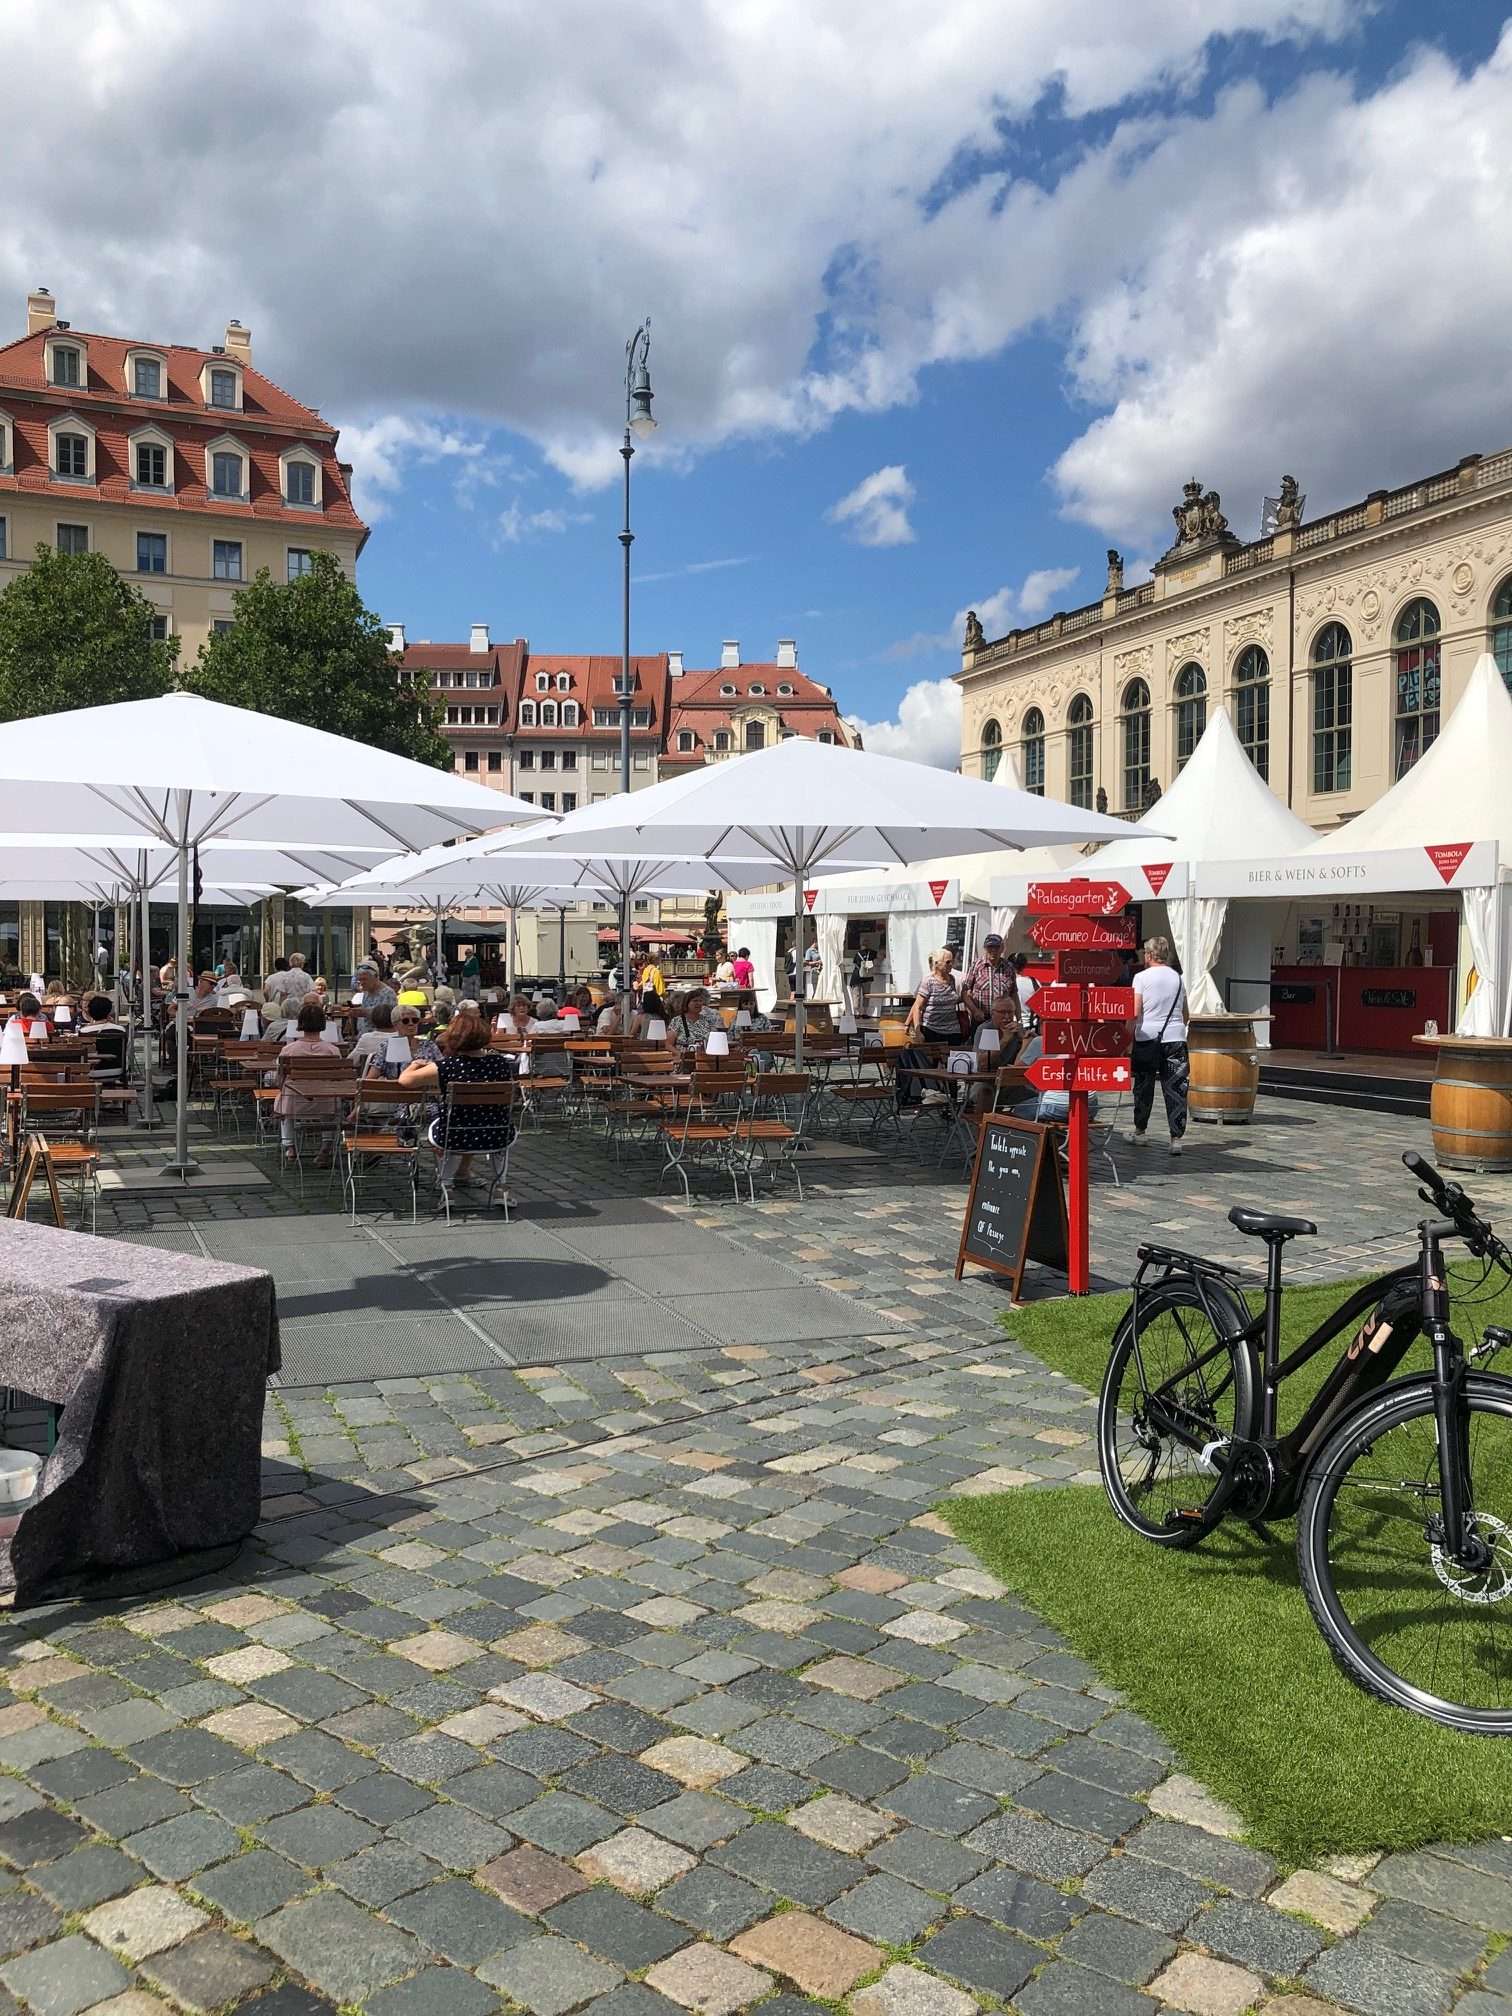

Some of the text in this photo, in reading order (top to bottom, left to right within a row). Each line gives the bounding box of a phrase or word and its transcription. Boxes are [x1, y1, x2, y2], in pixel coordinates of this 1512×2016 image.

[1248, 865, 1367, 882] BIER & WEIN & SOFTS
[1036, 889, 1104, 910] Palaisgarten
[1044, 920, 1130, 948] Comuneo Lounge
[1043, 989, 1125, 1015] Fama Piktura
[1070, 1025, 1107, 1052] WC
[1042, 1066, 1109, 1081] Erste Hilfe
